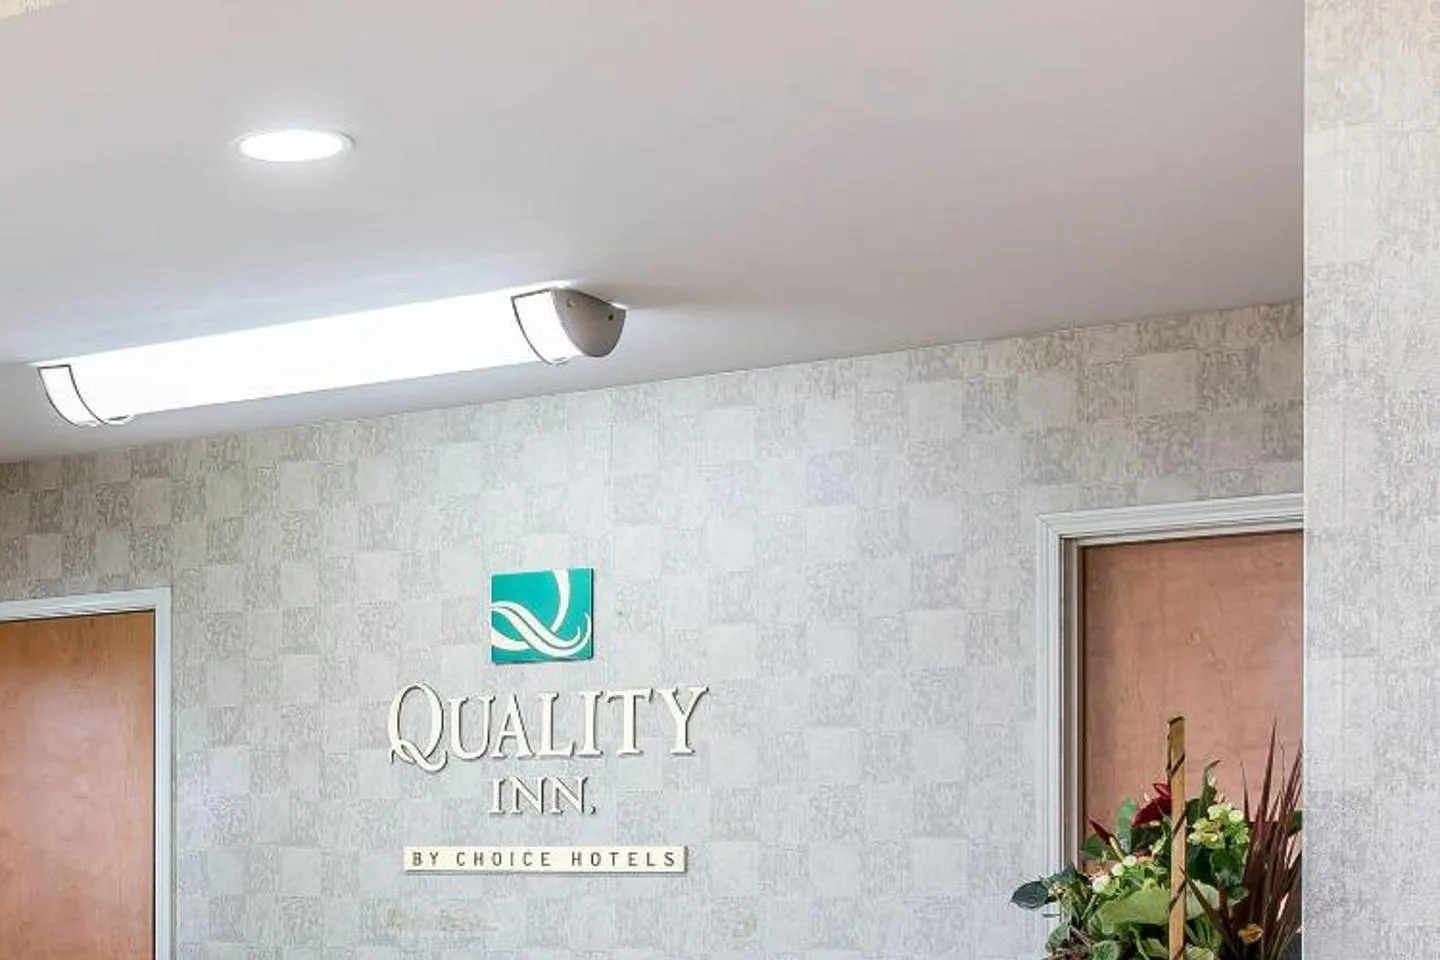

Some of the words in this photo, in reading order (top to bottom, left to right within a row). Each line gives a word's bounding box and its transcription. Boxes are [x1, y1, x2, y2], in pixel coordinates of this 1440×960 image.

[387, 683, 709, 773] QUALITY
[412, 851, 439, 867] BY
[456, 850, 551, 867] CHOICE
[571, 849, 676, 867] HOTELS
